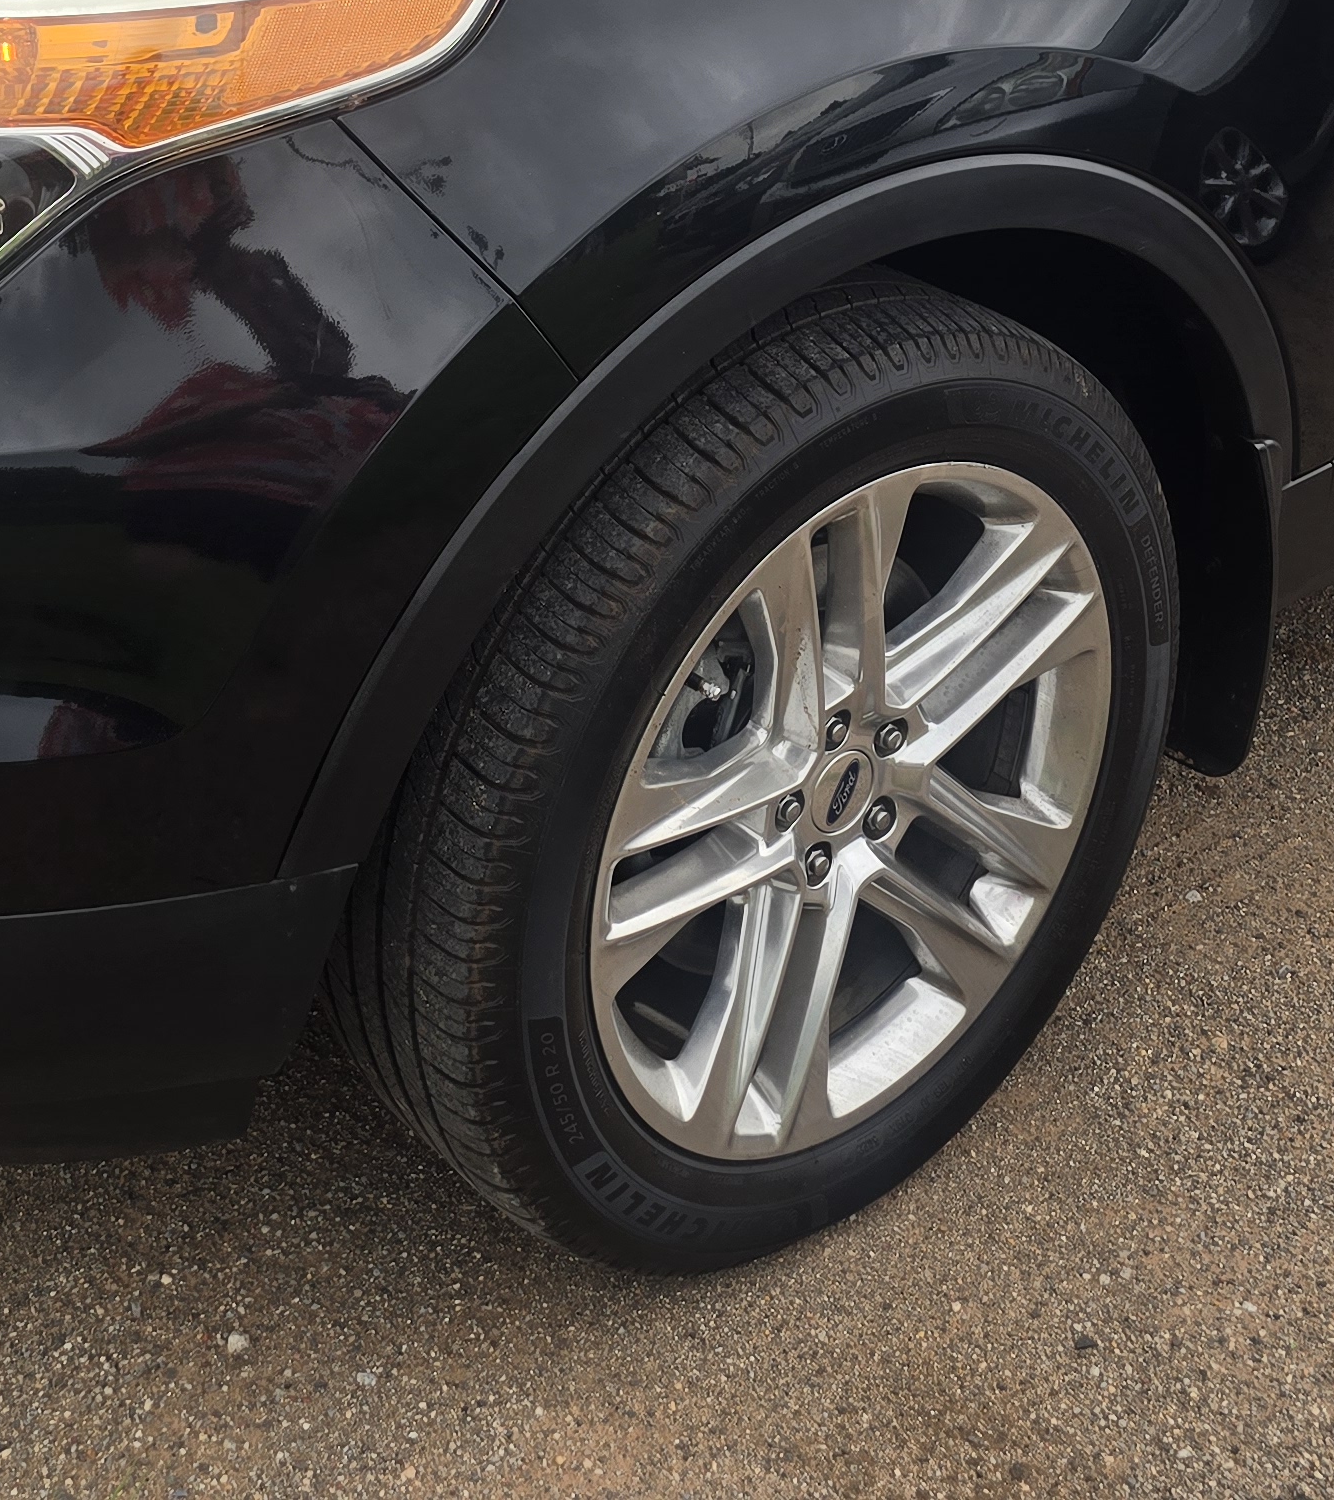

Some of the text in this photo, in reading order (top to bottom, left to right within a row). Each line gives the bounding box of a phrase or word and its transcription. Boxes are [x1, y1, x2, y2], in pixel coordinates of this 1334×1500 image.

[754, 468, 791, 501] TRACTION
[1010, 398, 1140, 515] MICHELIN
[1140, 534, 1164, 623] DEFENDER
[832, 770, 857, 815] Ford
[540, 1032, 585, 1145] 245/50 R 20
